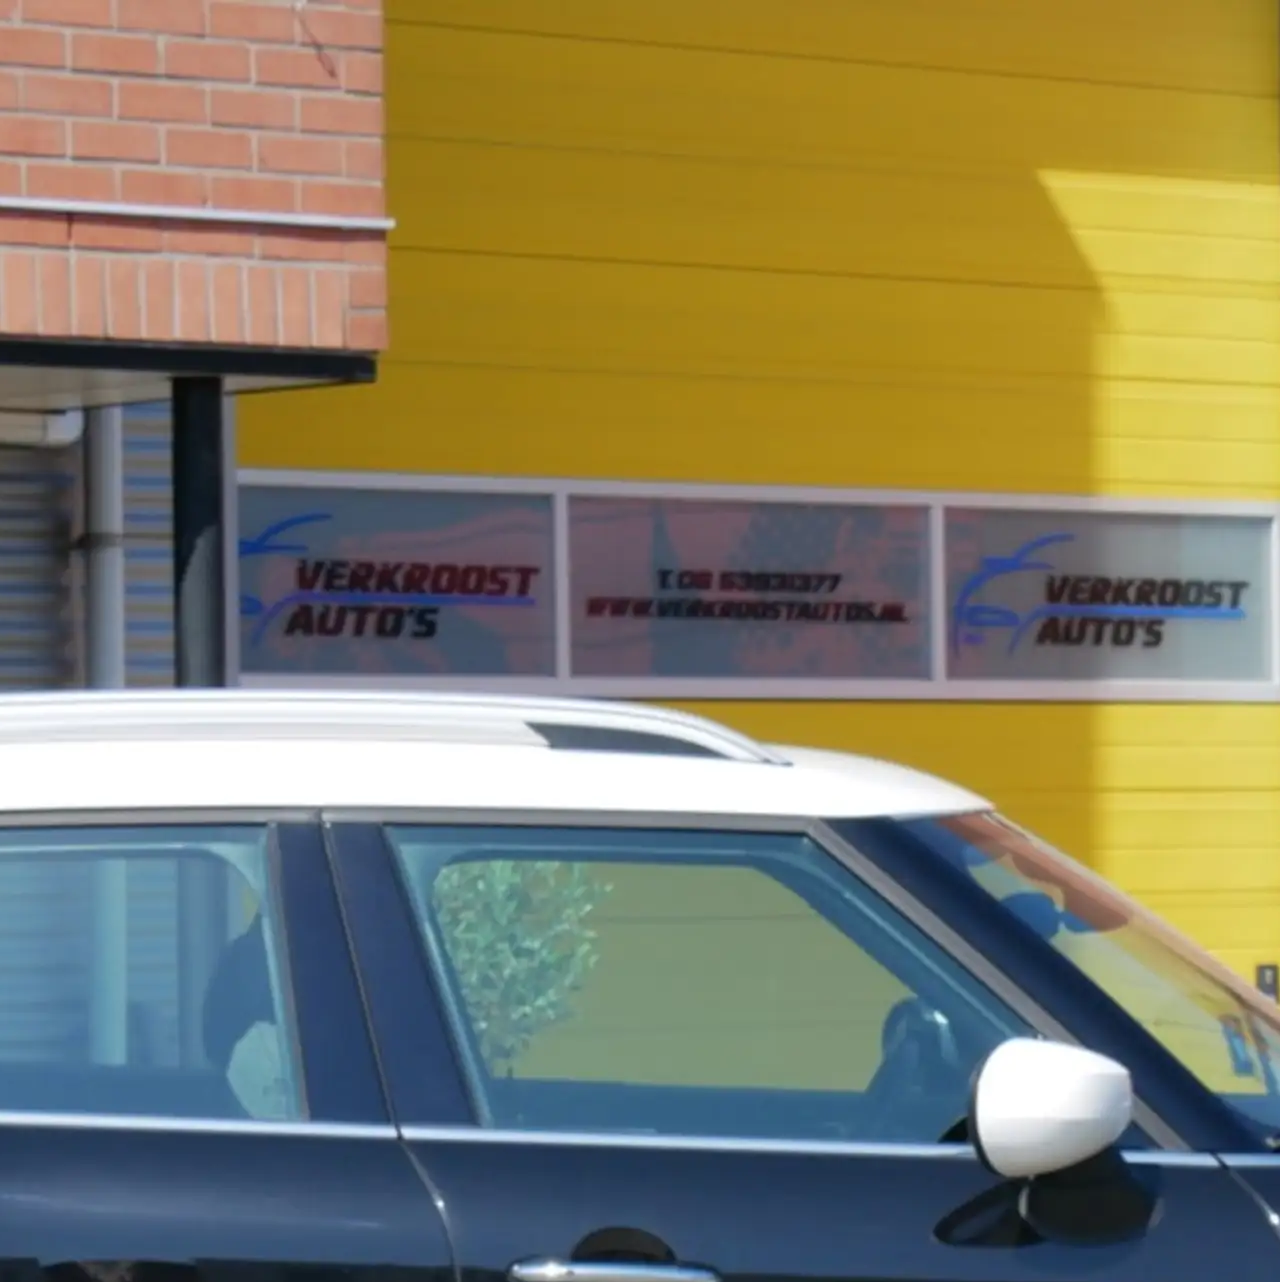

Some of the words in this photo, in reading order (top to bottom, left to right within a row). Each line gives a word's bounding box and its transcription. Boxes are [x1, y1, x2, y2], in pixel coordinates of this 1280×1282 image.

[296, 558, 540, 597] VERKROOST
[1045, 575, 1250, 610] VERKROOST
[284, 604, 440, 640] AUTO'S
[1035, 616, 1168, 648] AUTO'S
